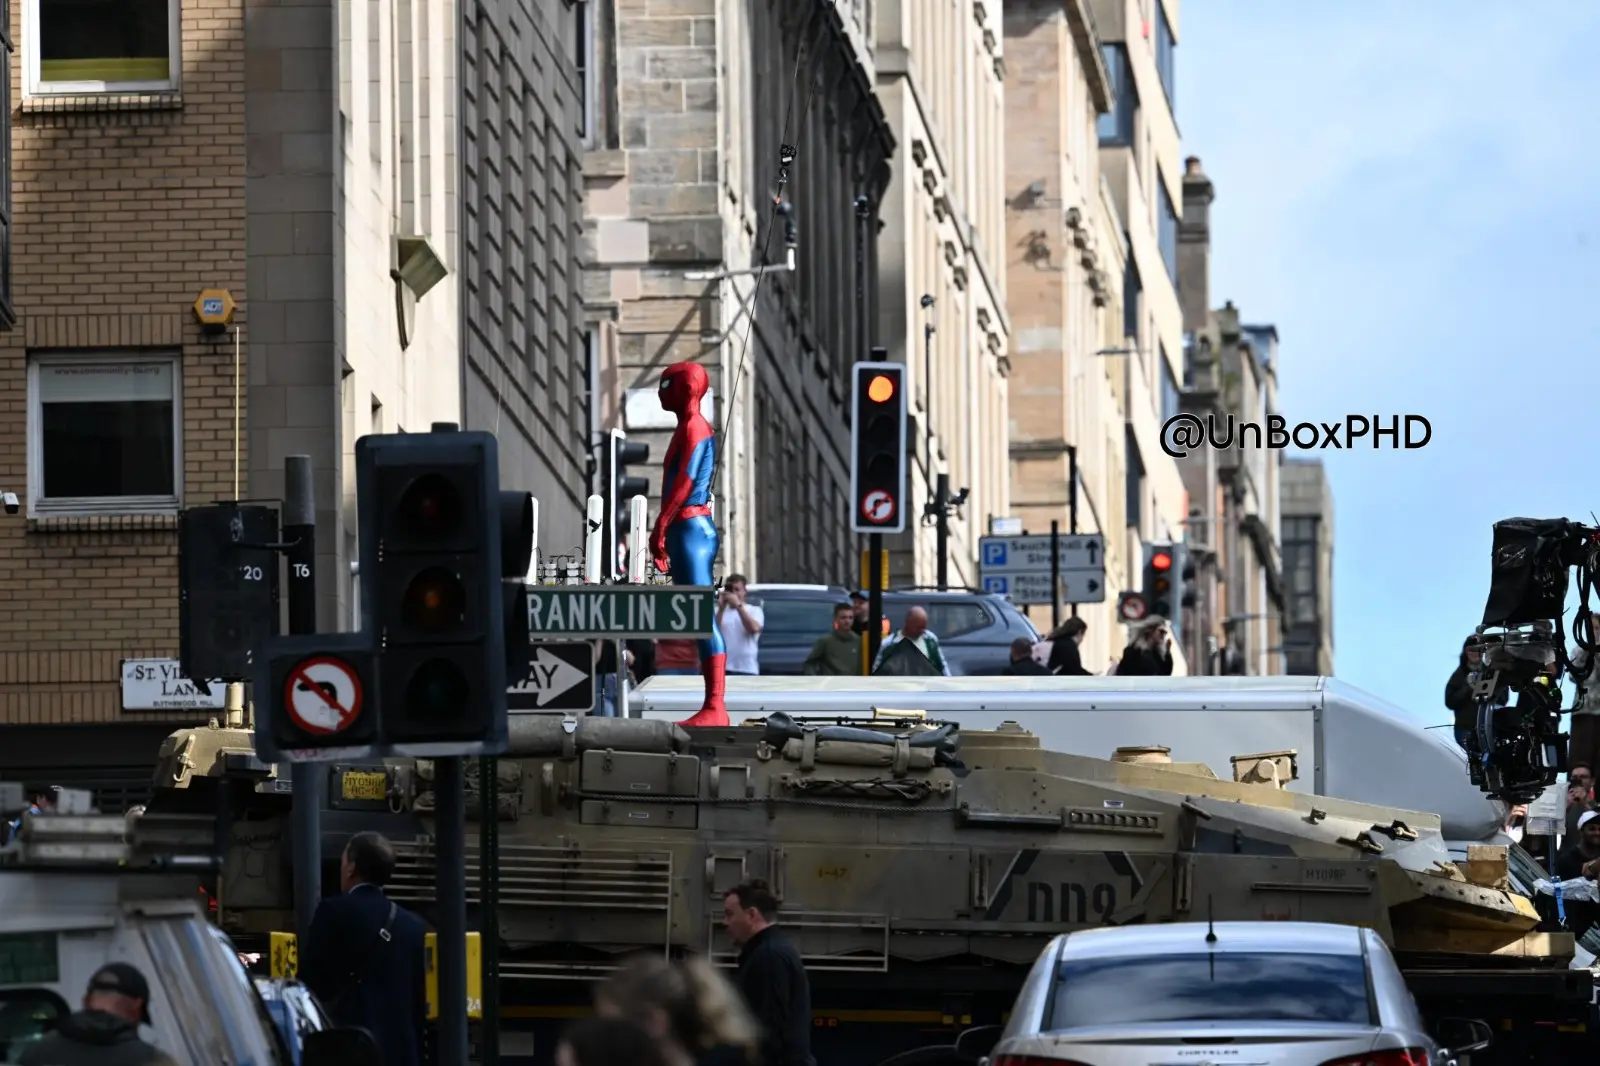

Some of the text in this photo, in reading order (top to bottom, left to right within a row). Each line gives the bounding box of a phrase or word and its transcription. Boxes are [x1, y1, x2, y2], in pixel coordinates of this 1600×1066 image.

[243, 565, 263, 580] 20
[292, 563, 310, 577] T6
[528, 594, 704, 631] RANKLIN ST
[515, 665, 560, 689] AY
